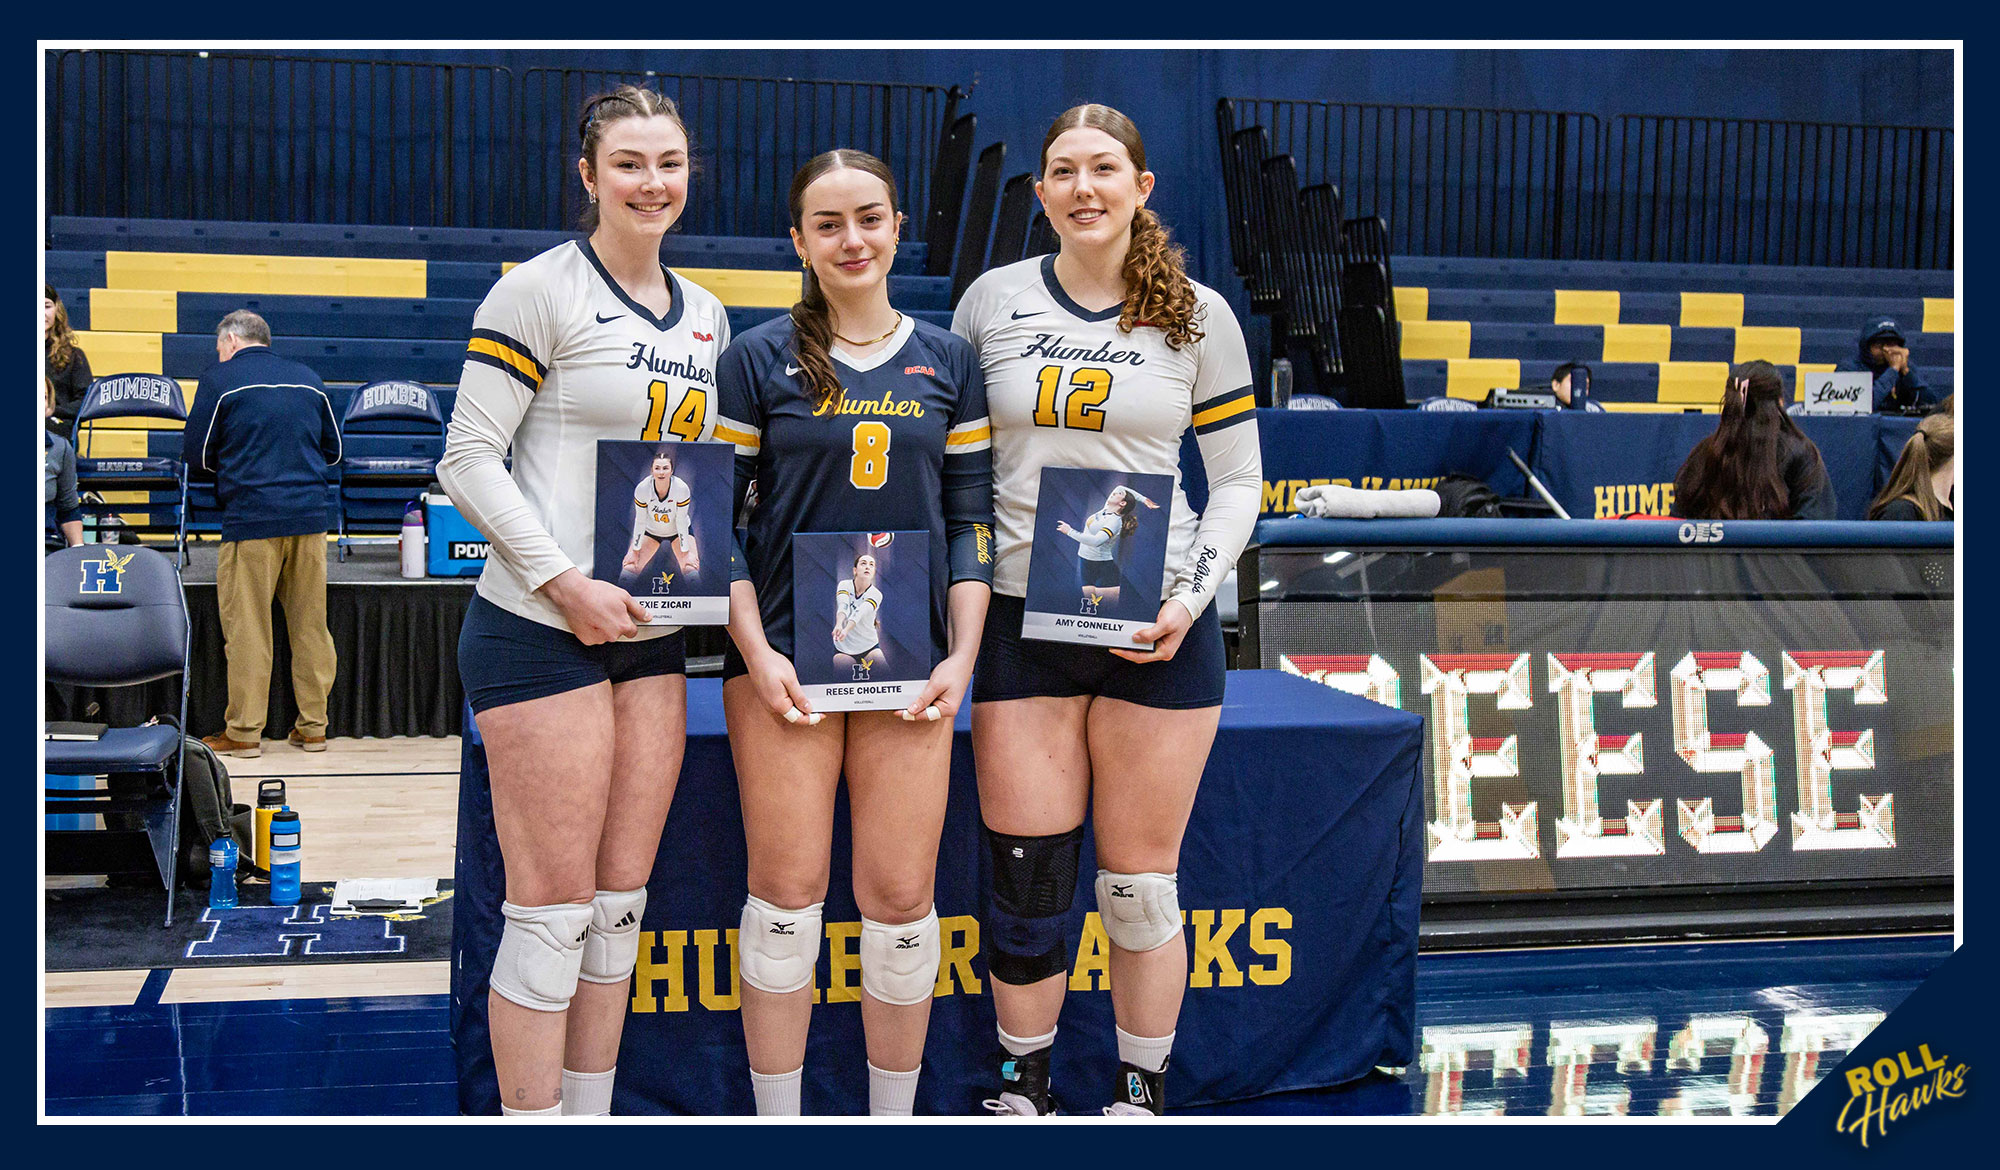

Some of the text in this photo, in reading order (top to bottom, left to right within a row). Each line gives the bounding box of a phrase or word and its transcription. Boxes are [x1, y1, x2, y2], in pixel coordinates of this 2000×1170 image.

[1020, 333, 1145, 366] Humber
[626, 341, 715, 388] Humber
[99, 377, 171, 406] HUMBER
[362, 383, 428, 411] HUMBER
[1032, 364, 1114, 433] 12
[1812, 381, 1861, 405] Lewis
[640, 378, 706, 443] 14
[97, 461, 143, 472] HAWKS
[850, 421, 891, 489] 8
[653, 513, 670, 524] 14
[1678, 522, 1724, 544] OES
[660, 600, 692, 609] ZICARI
[1055, 618, 1124, 632] AMY CONNELLY
[826, 685, 902, 696] REESE CHOLETTE
